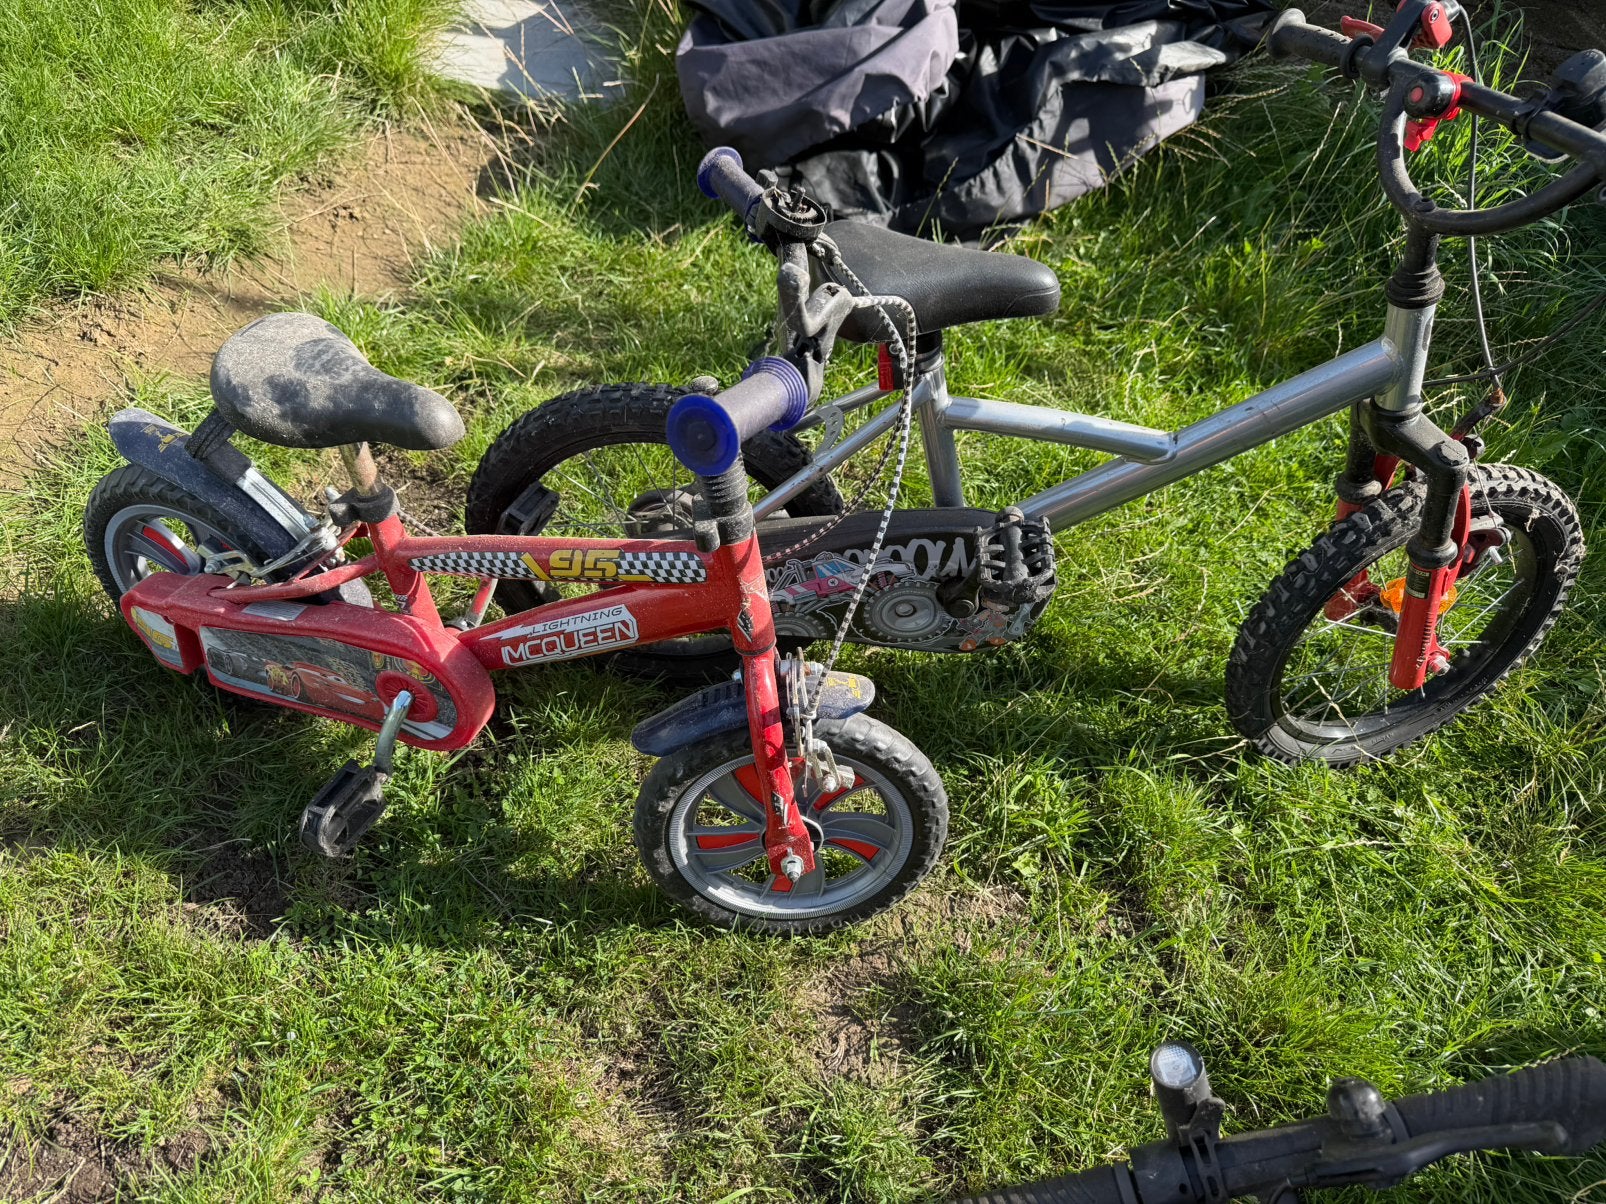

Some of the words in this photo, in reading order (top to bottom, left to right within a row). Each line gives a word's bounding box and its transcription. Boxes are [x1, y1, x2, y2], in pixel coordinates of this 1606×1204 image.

[549, 549, 620, 577] 95
[532, 606, 623, 634] LIGHTNING
[502, 620, 636, 662] MCQUEEN
